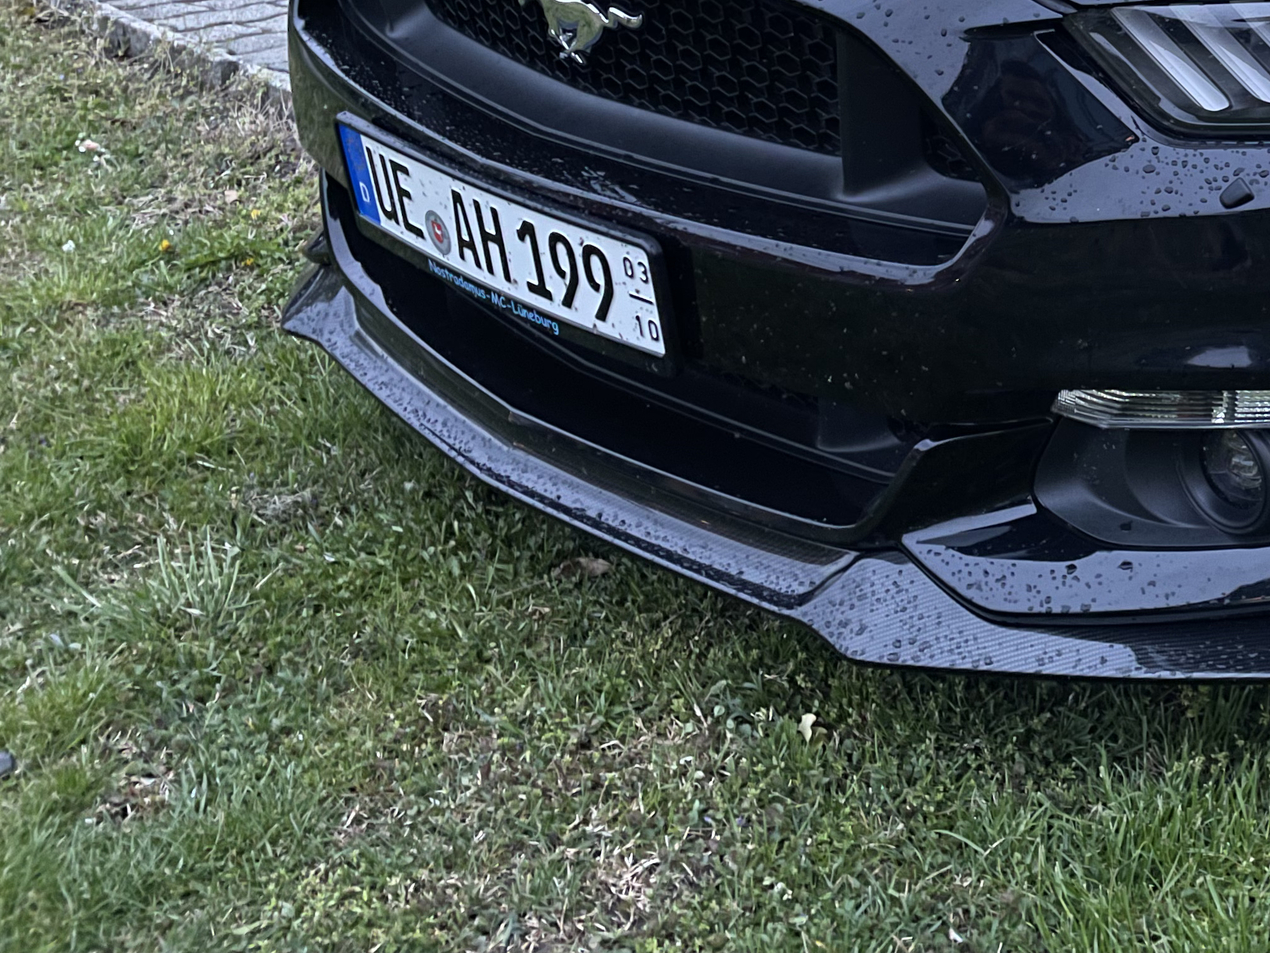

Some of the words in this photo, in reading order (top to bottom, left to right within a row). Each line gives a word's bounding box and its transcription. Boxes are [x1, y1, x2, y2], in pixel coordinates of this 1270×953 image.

[359, 181, 371, 203] D
[365, 145, 426, 241] UE
[451, 188, 513, 284] AH
[516, 219, 615, 323] 199
[623, 256, 650, 284] 03
[634, 314, 660, 342] 10
